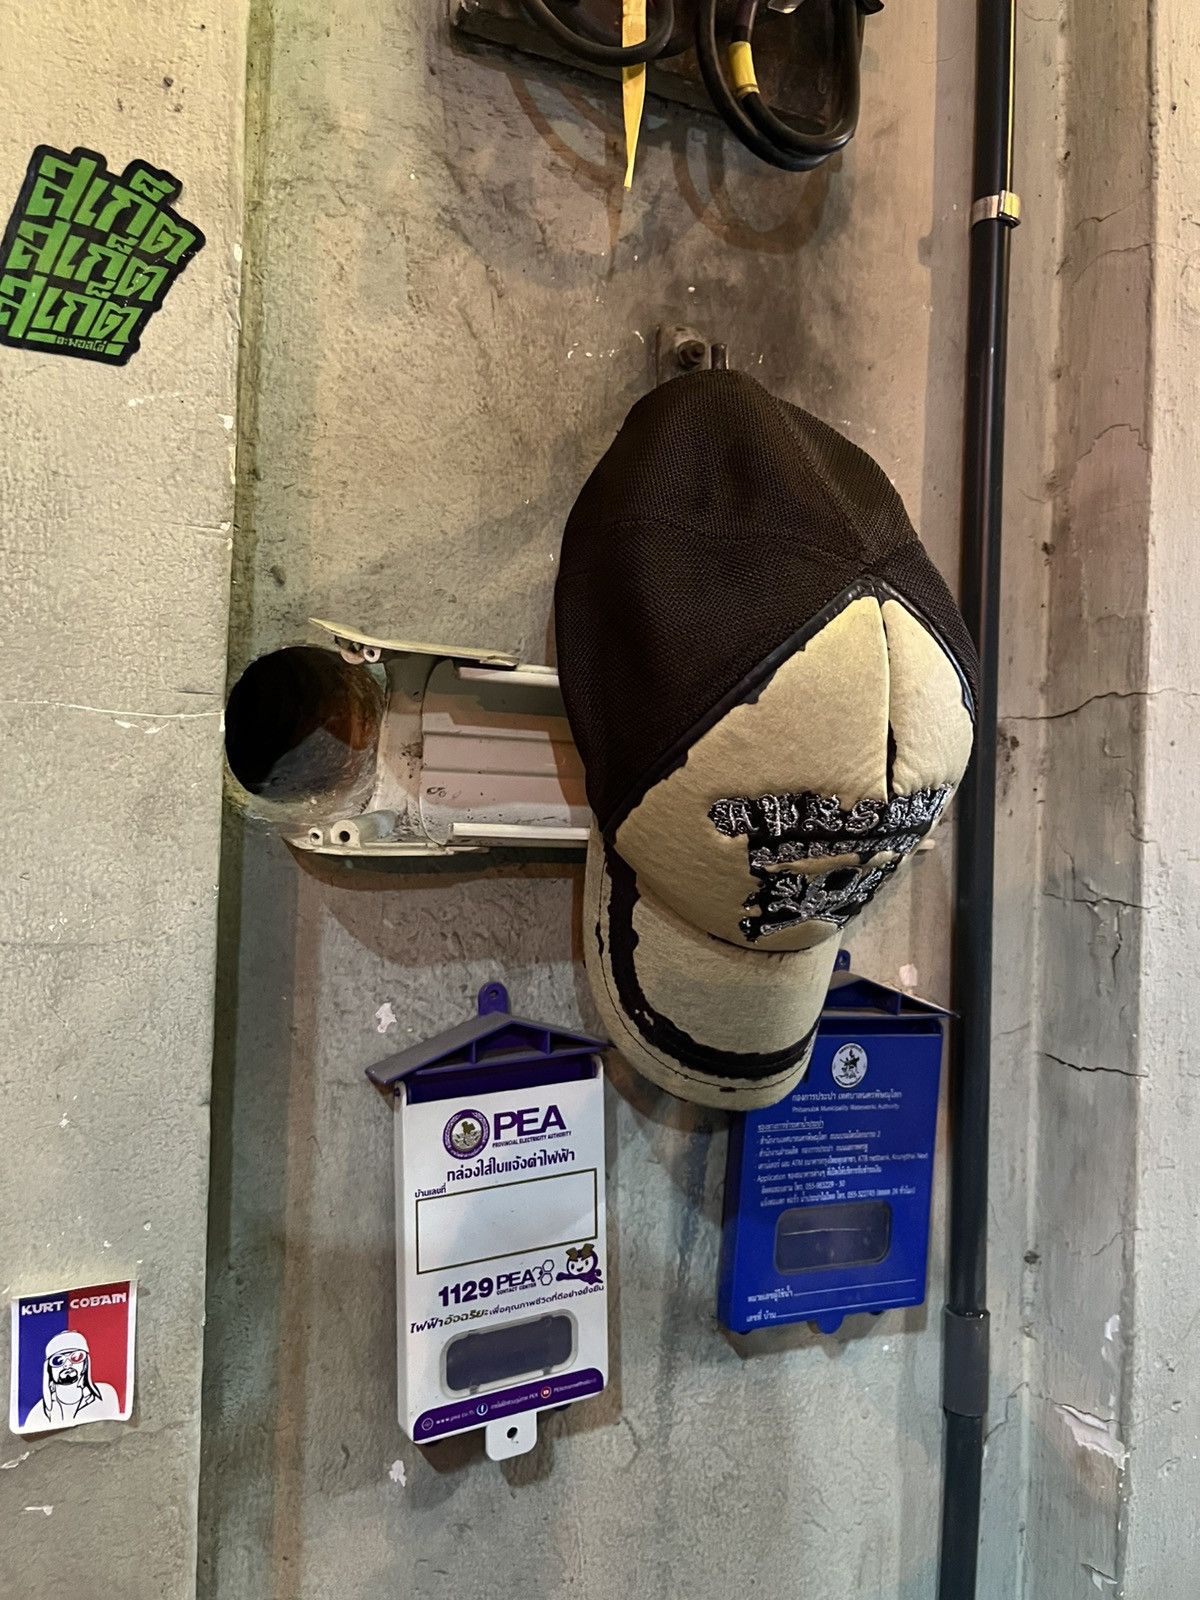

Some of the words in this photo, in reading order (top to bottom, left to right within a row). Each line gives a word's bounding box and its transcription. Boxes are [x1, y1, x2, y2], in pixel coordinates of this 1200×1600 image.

[494, 1105, 566, 1140] PEA
[548, 1130, 572, 1139] AUTHORITY
[447, 1149, 575, 1182] กล่องใส่ใบแจ้งค่าไฟฟ้า
[415, 1183, 446, 1198] บ้านเลขที่
[438, 1277, 493, 1307] 1129
[496, 1269, 535, 1290] PEA
[497, 1285, 518, 1295] CONTACT
[21, 1301, 64, 1316] KURT
[70, 1292, 127, 1309] COBAIN
